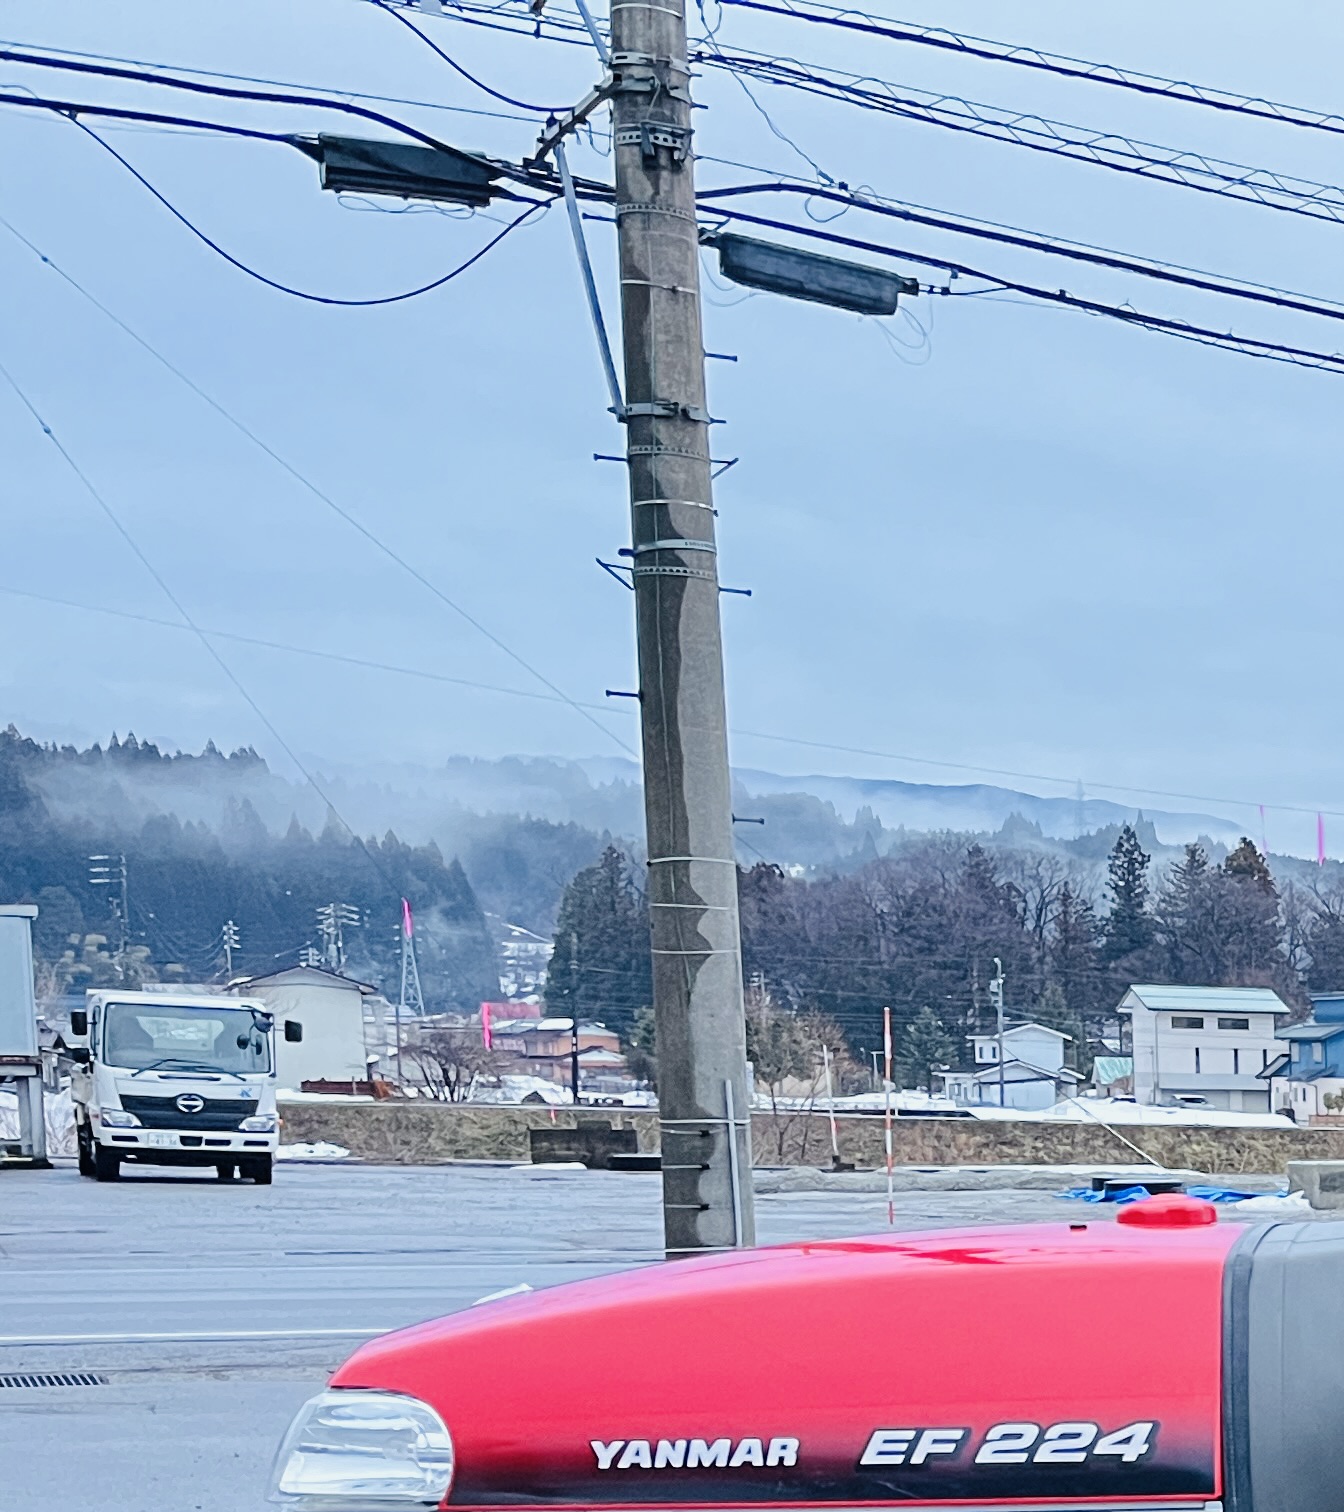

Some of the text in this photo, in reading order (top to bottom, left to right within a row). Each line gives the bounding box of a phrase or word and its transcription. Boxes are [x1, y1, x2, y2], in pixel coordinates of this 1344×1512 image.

[589, 1421, 1156, 1470] YANMAR EF 224
